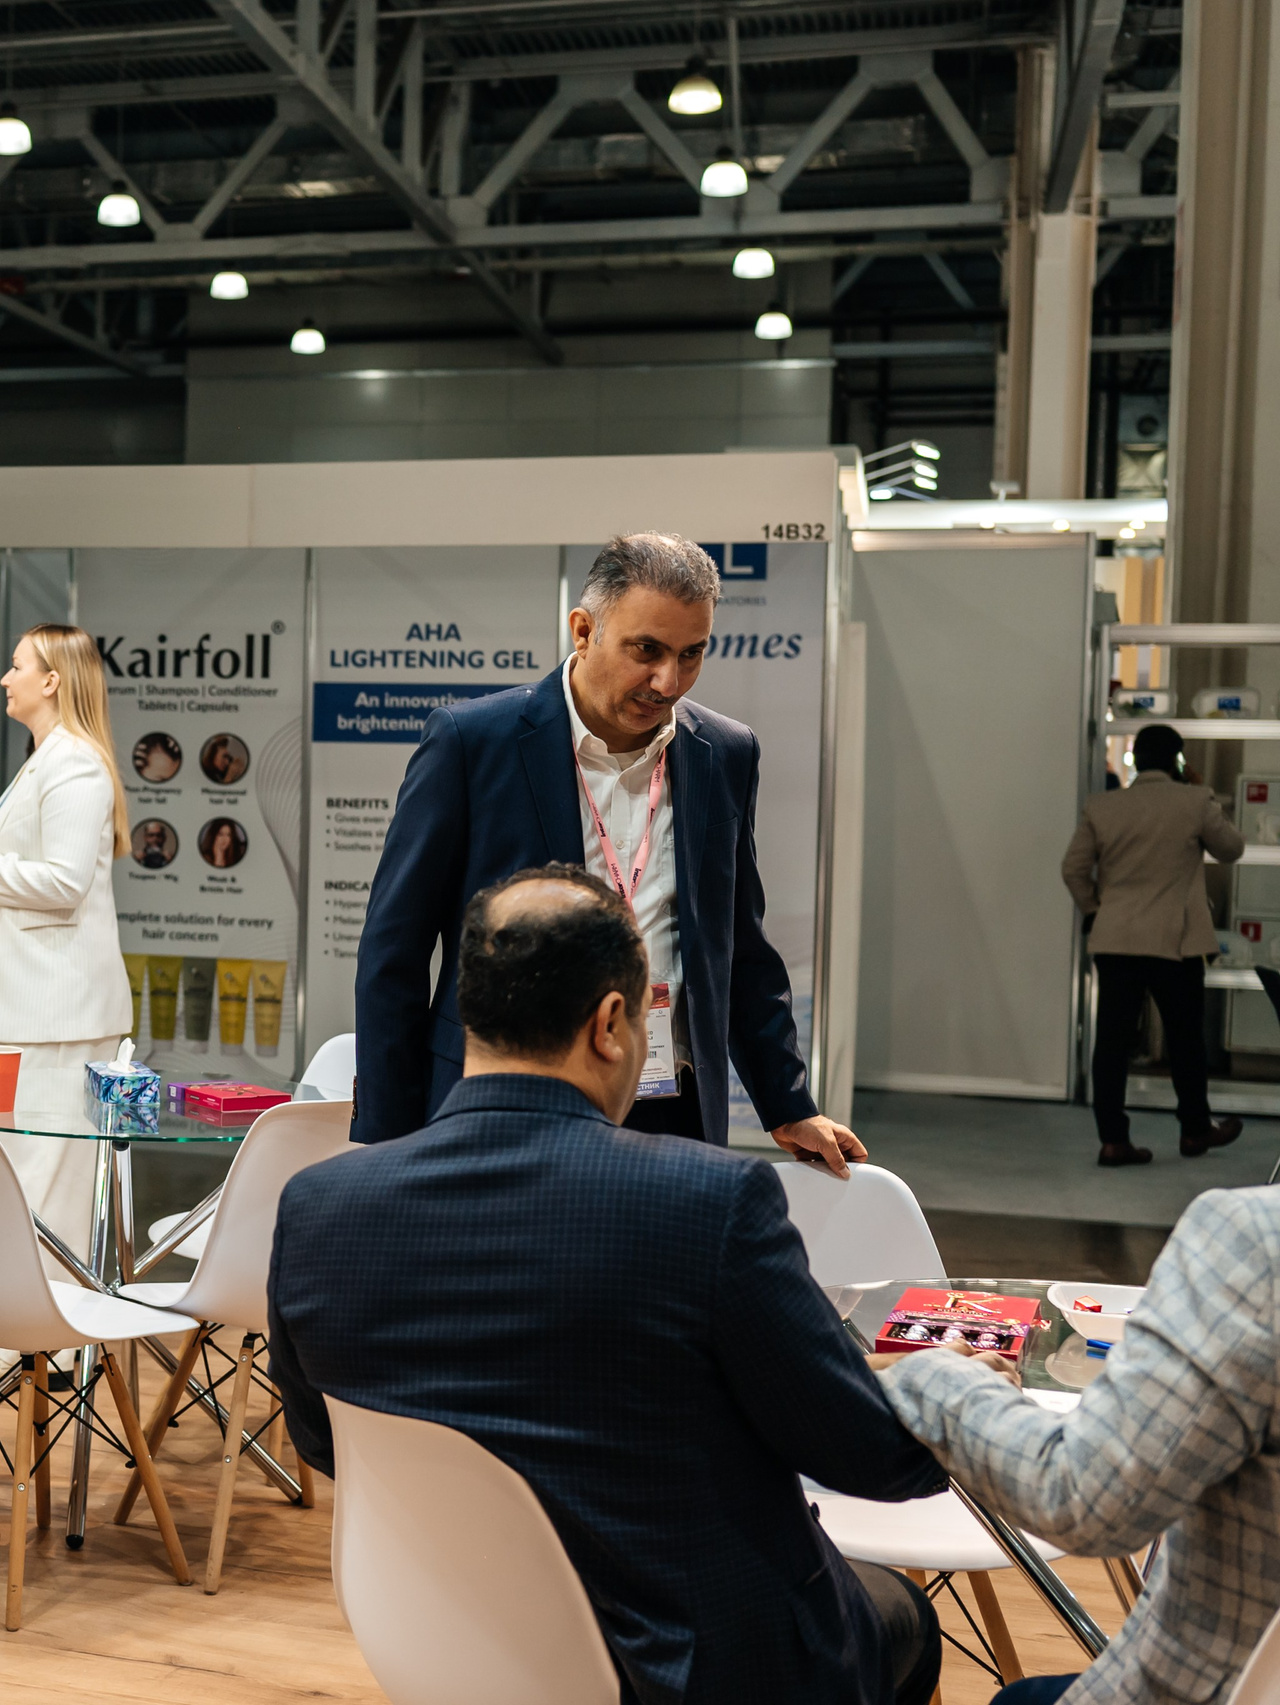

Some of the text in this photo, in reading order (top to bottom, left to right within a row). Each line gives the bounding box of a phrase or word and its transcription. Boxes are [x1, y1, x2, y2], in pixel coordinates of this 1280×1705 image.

[761, 523, 826, 541] 14B32
[405, 622, 462, 642] AHA
[95, 633, 272, 679] Kairfoll
[329, 649, 540, 670] LIGHTENING GEL
[107, 685, 279, 698] erum Shampoo Conditioner
[354, 692, 381, 708] An
[137, 699, 240, 714] Tablets Capsules
[337, 713, 424, 735] brightenin
[326, 797, 389, 810] BENEFITS
[324, 880, 370, 892] INDICA
[164, 912, 216, 927] solution
[217, 914, 236, 928] for
[238, 917, 274, 931] every
[141, 927, 219, 943] hair concern
